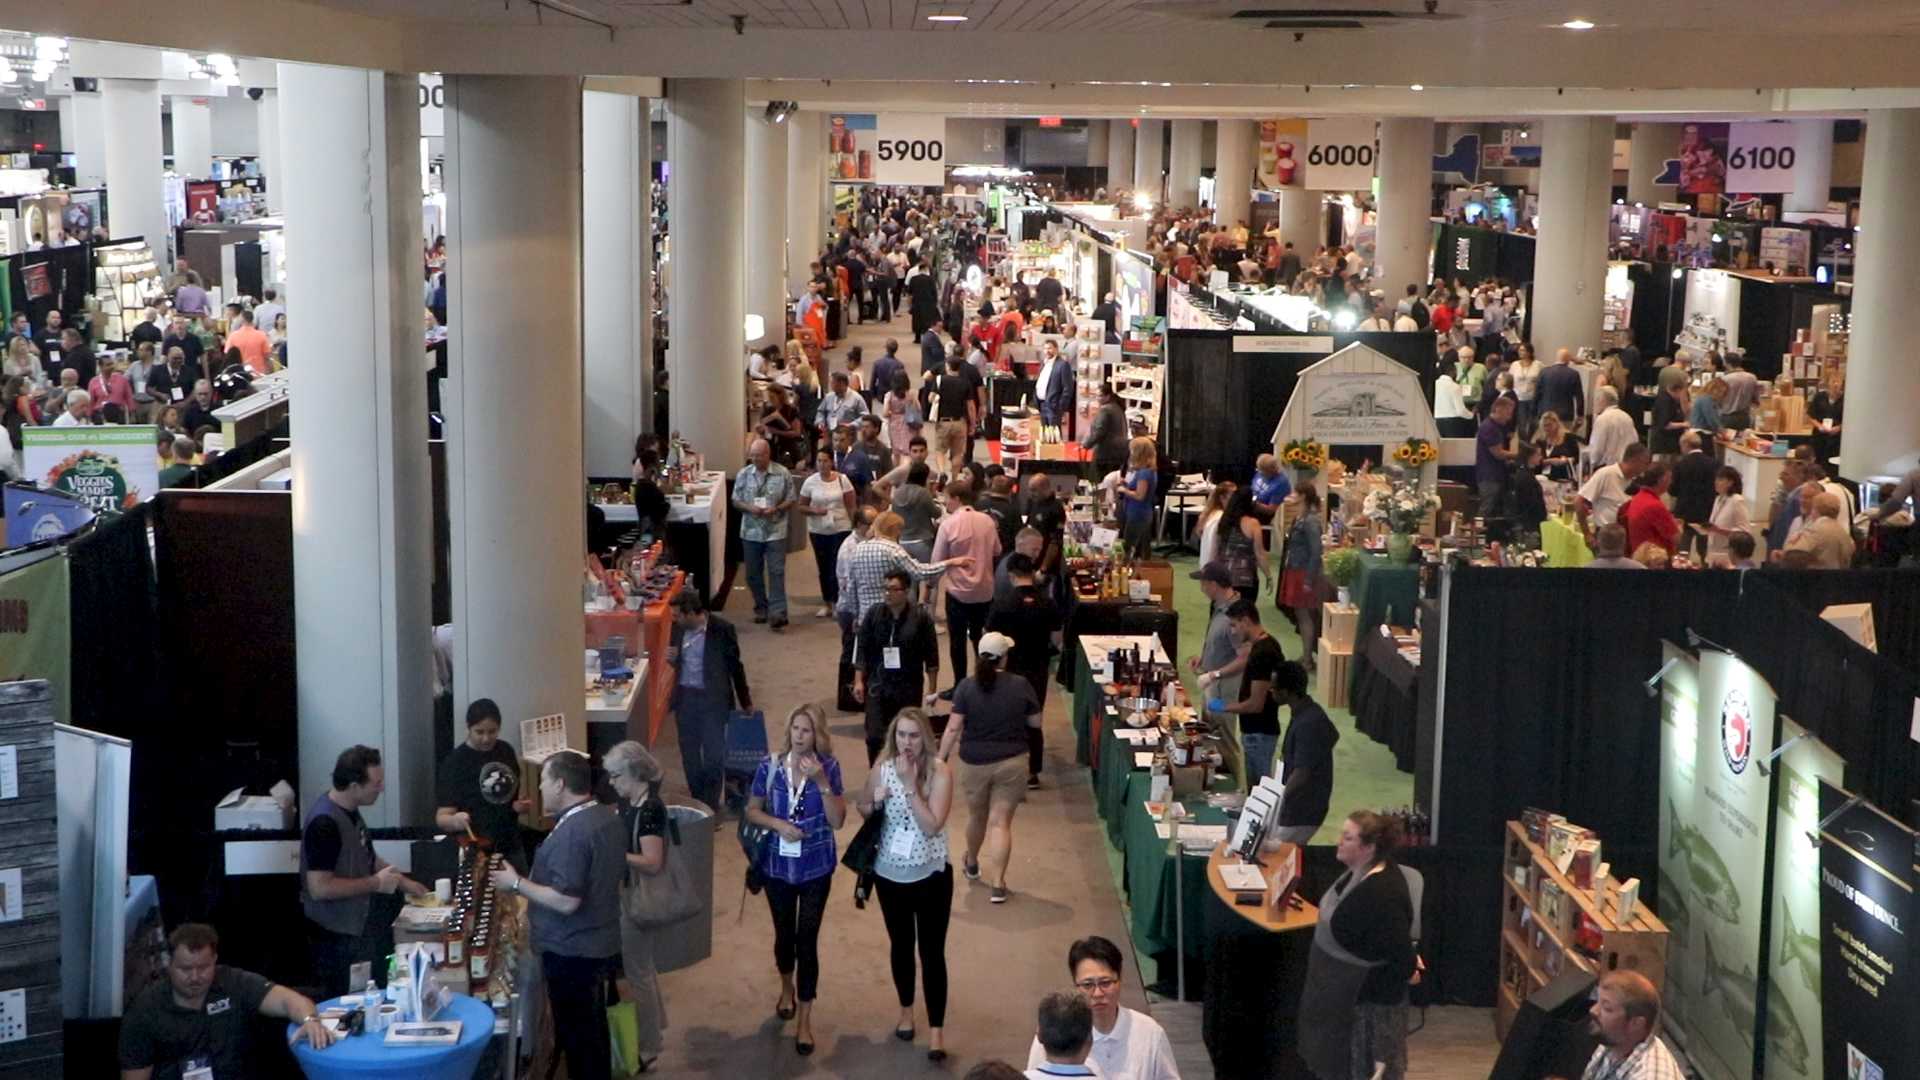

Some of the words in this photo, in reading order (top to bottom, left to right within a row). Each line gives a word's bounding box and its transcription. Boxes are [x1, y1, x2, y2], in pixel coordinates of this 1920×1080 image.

[877, 140, 943, 161] 5900
[1307, 145, 1373, 166] 6000
[1729, 147, 1796, 170] 6100
[99, 433, 155, 441] INGREDIENT
[66, 475, 115, 490] VEGGIES
[76, 486, 114, 496] MADE
[1822, 866, 1845, 894] PROUD
[1845, 884, 1855, 901] OF
[1833, 922, 1850, 943] Small
[1850, 933, 1868, 957] batch
[1868, 950, 1894, 976] smoked
[1848, 966, 1860, 986] Dry
